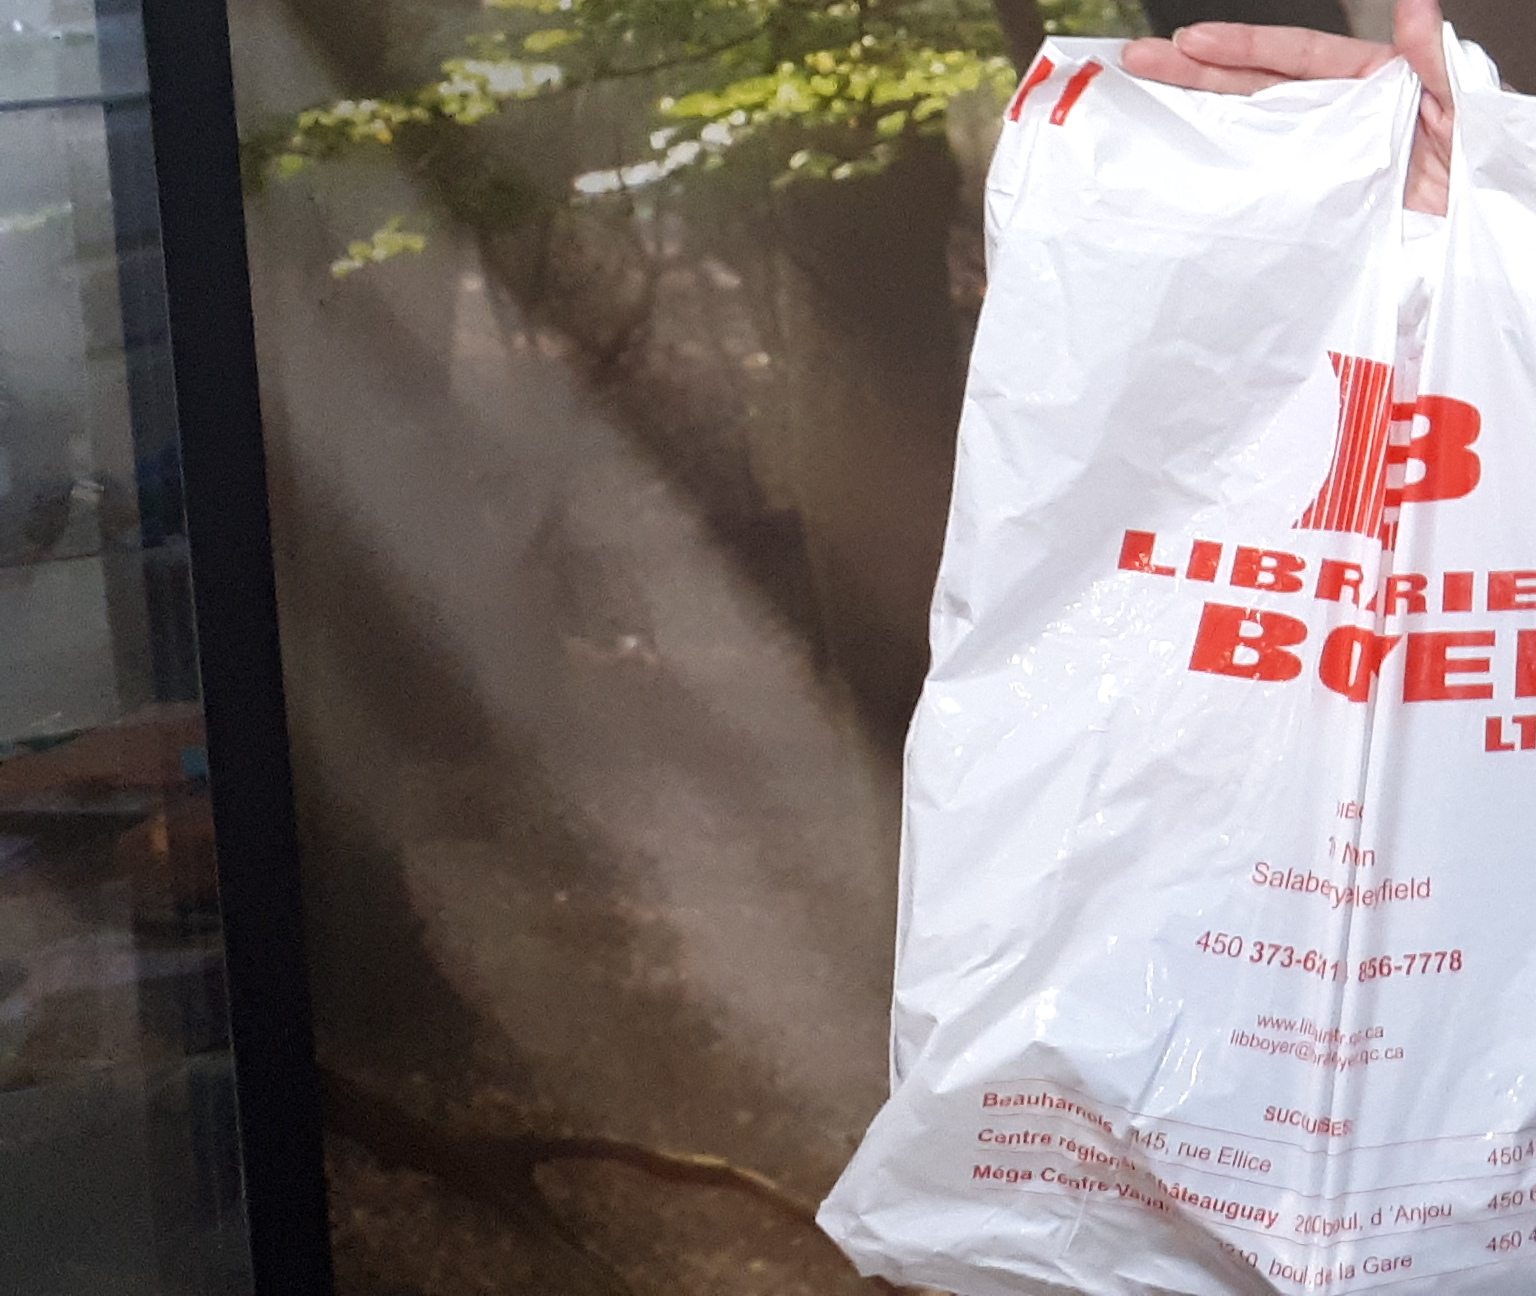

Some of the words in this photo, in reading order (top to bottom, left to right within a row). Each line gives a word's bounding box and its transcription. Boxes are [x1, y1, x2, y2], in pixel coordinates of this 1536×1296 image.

[1195, 930, 1244, 959] 450
[982, 1092, 1114, 1134] Beauharnois
[1178, 1140, 1212, 1162] rue
[1217, 1146, 1273, 1174] Ellice
[1487, 1143, 1523, 1167] 450
[977, 1128, 1052, 1145] Centre
[1487, 1191, 1524, 1212] 450
[1339, 1261, 1356, 1281] la
[1362, 1254, 1414, 1276] Gare
[1486, 1232, 1523, 1253] 450
